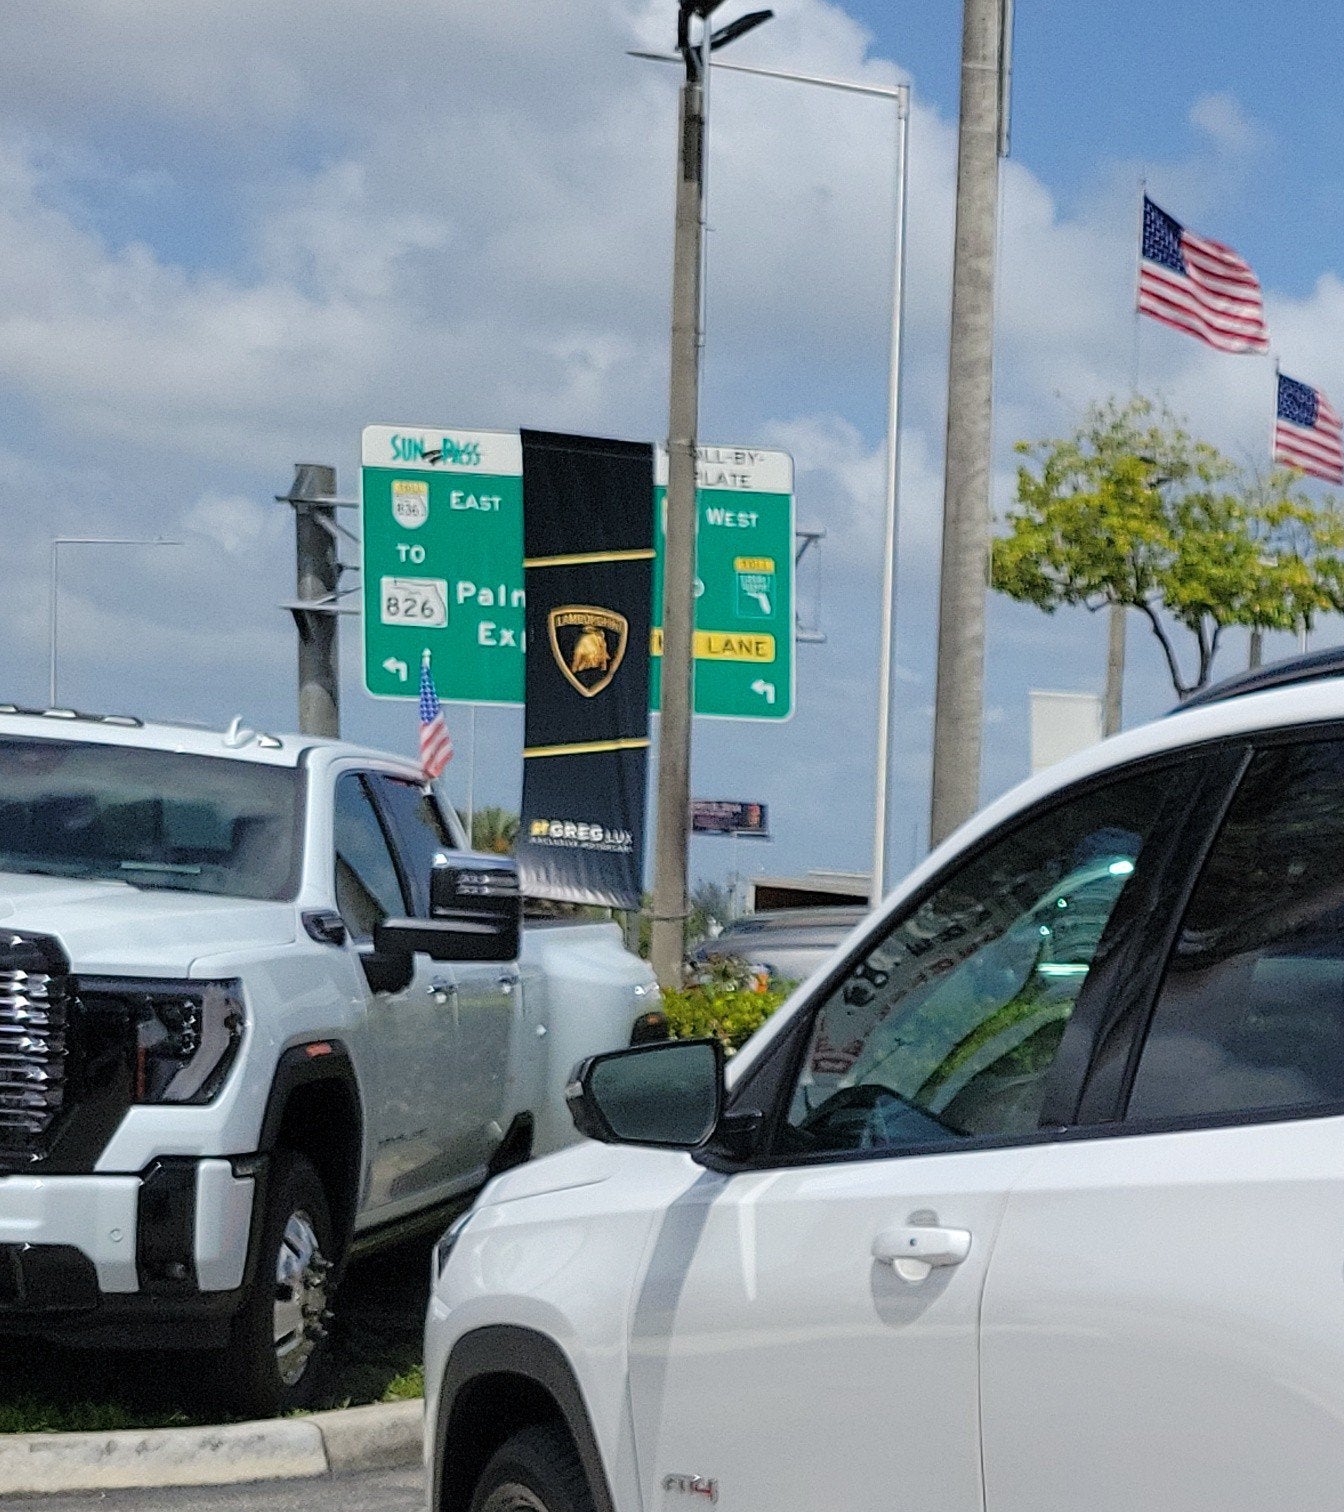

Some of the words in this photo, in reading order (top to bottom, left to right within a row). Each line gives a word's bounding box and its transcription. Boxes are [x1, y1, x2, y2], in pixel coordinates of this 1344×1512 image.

[694, 470, 752, 489] LATE
[451, 490, 502, 511] EAST
[706, 506, 759, 528] WEST
[396, 543, 426, 564] TO
[387, 596, 434, 618] 826
[478, 620, 526, 654] Ex
[708, 637, 768, 658] LANE
